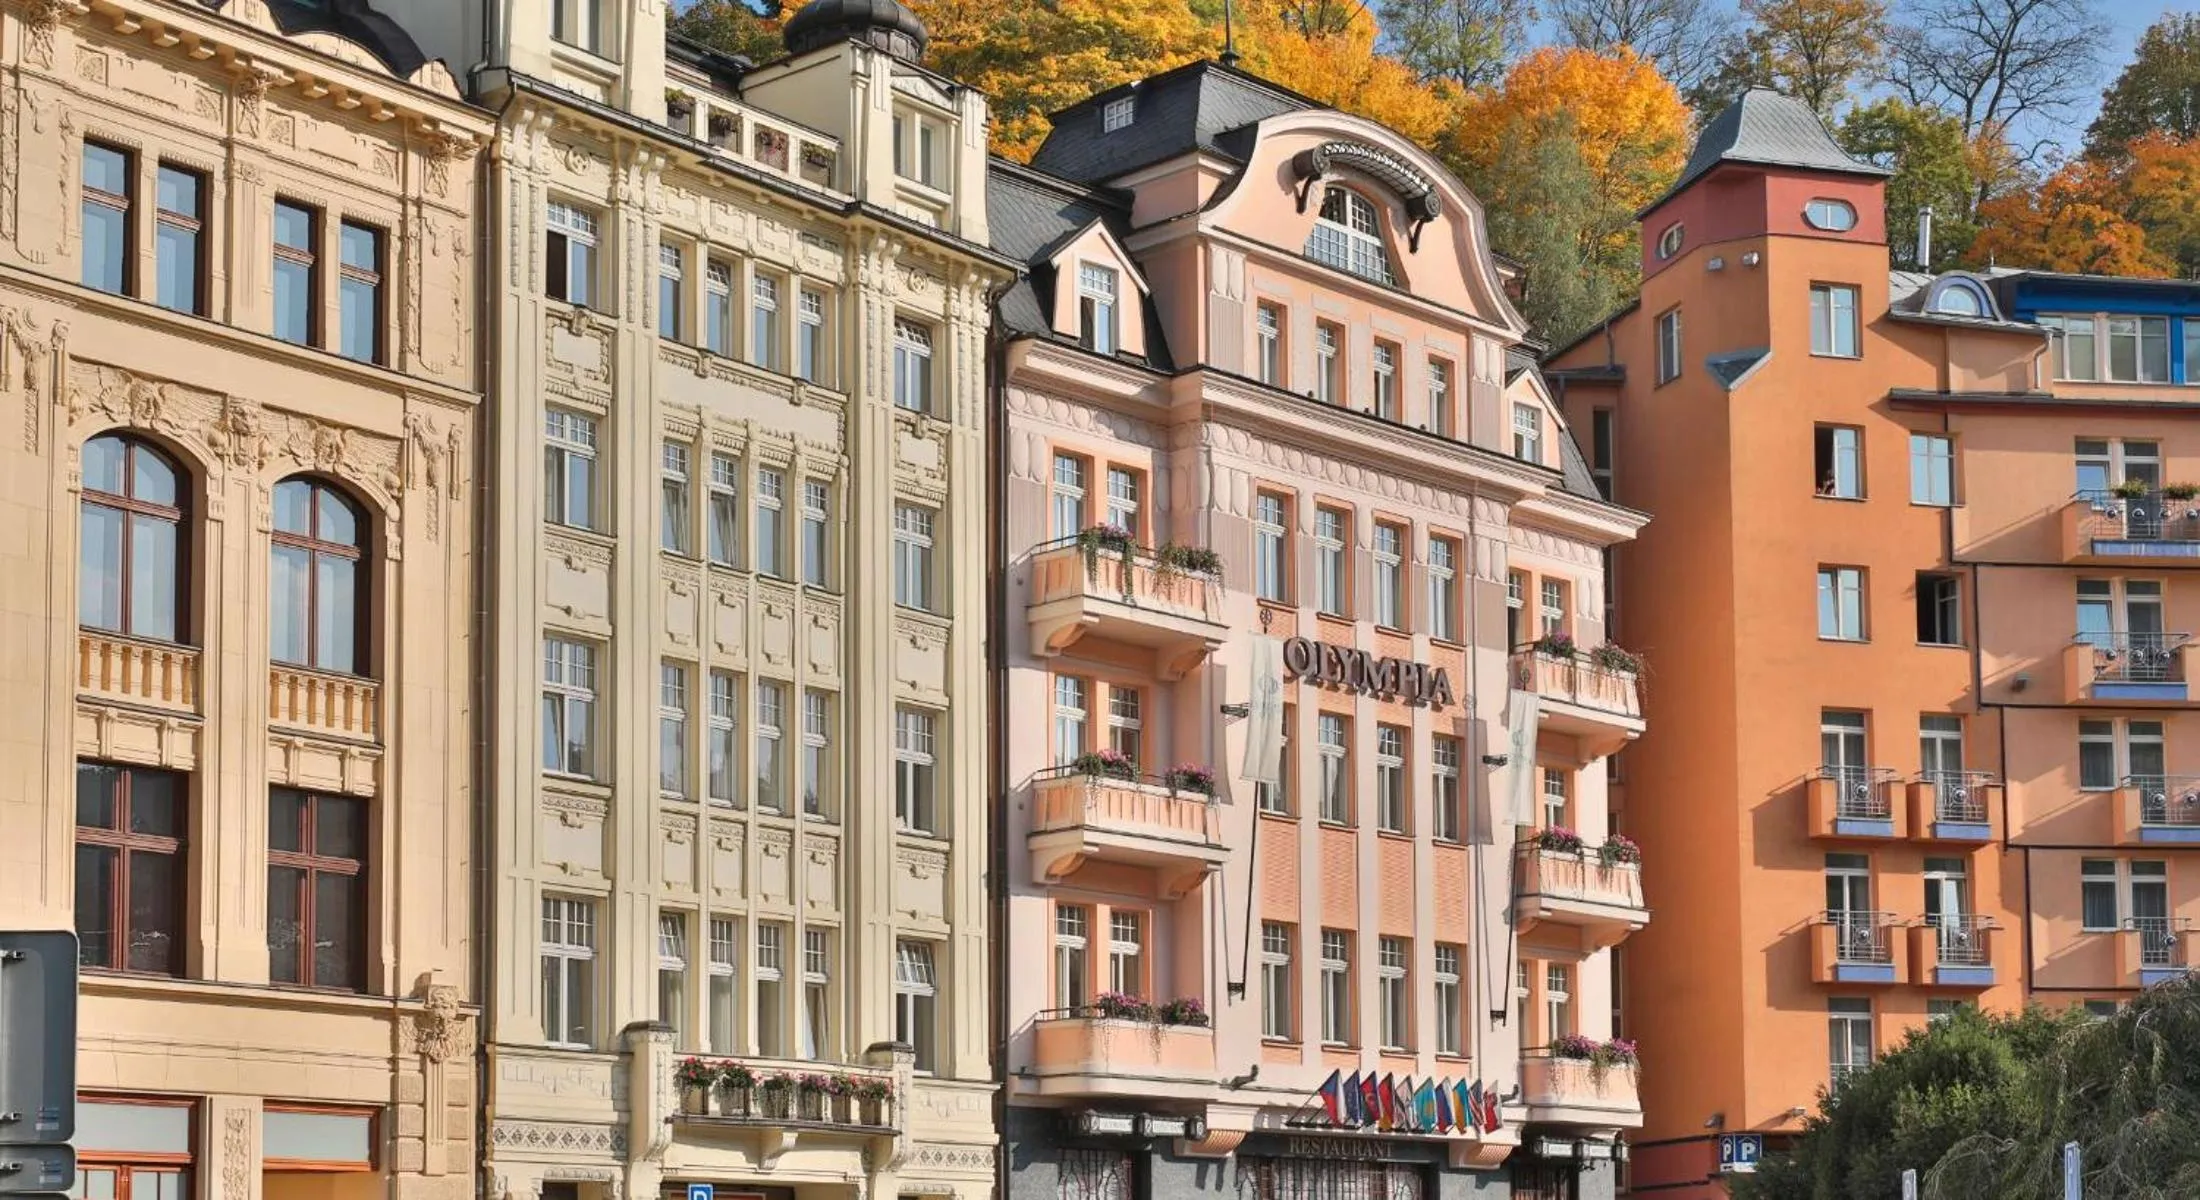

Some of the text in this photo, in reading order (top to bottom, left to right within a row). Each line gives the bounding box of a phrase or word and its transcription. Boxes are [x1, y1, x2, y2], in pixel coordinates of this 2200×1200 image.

[1283, 636, 1455, 705] OLYMPIA
[1289, 1136, 1392, 1158] RESTAURANT
[1723, 1143, 1732, 1161] P
[1741, 1142, 1756, 1161] P
